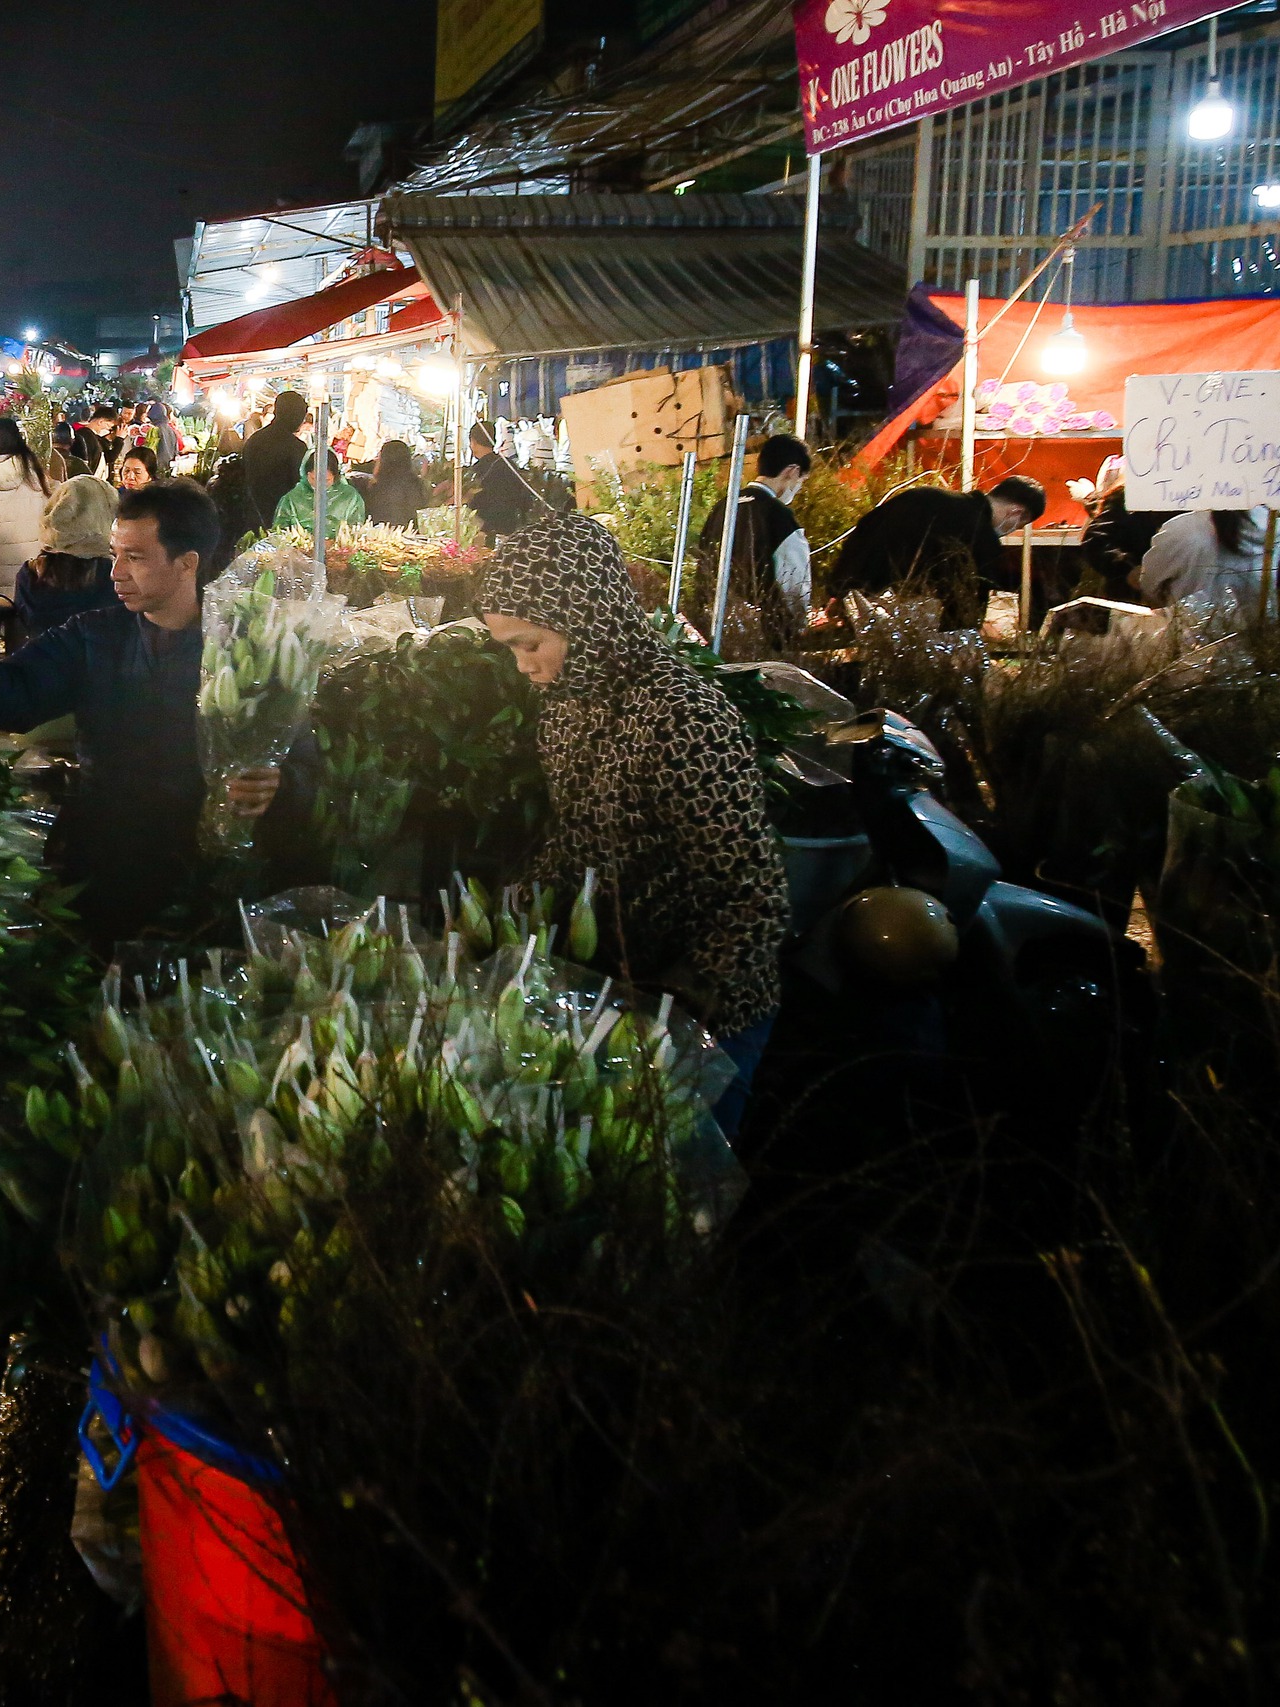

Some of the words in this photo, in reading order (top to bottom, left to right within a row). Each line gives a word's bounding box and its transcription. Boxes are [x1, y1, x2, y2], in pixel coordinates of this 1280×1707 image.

[831, 58, 861, 109] ONE
[862, 19, 944, 97] FLOWERS
[851, 109, 866, 131] Âu
[866, 107, 883, 125] Cơ
[884, 96, 912, 121] (Chợ
[913, 88, 939, 109] Hoa
[940, 71, 985, 100] Quảng
[986, 55, 1013, 82] An)
[1024, 40, 1055, 66] Tây
[1058, 20, 1085, 54] Hồ
[1099, 9, 1128, 39] Hà
[1130, 0, 1167, 27] Nội
